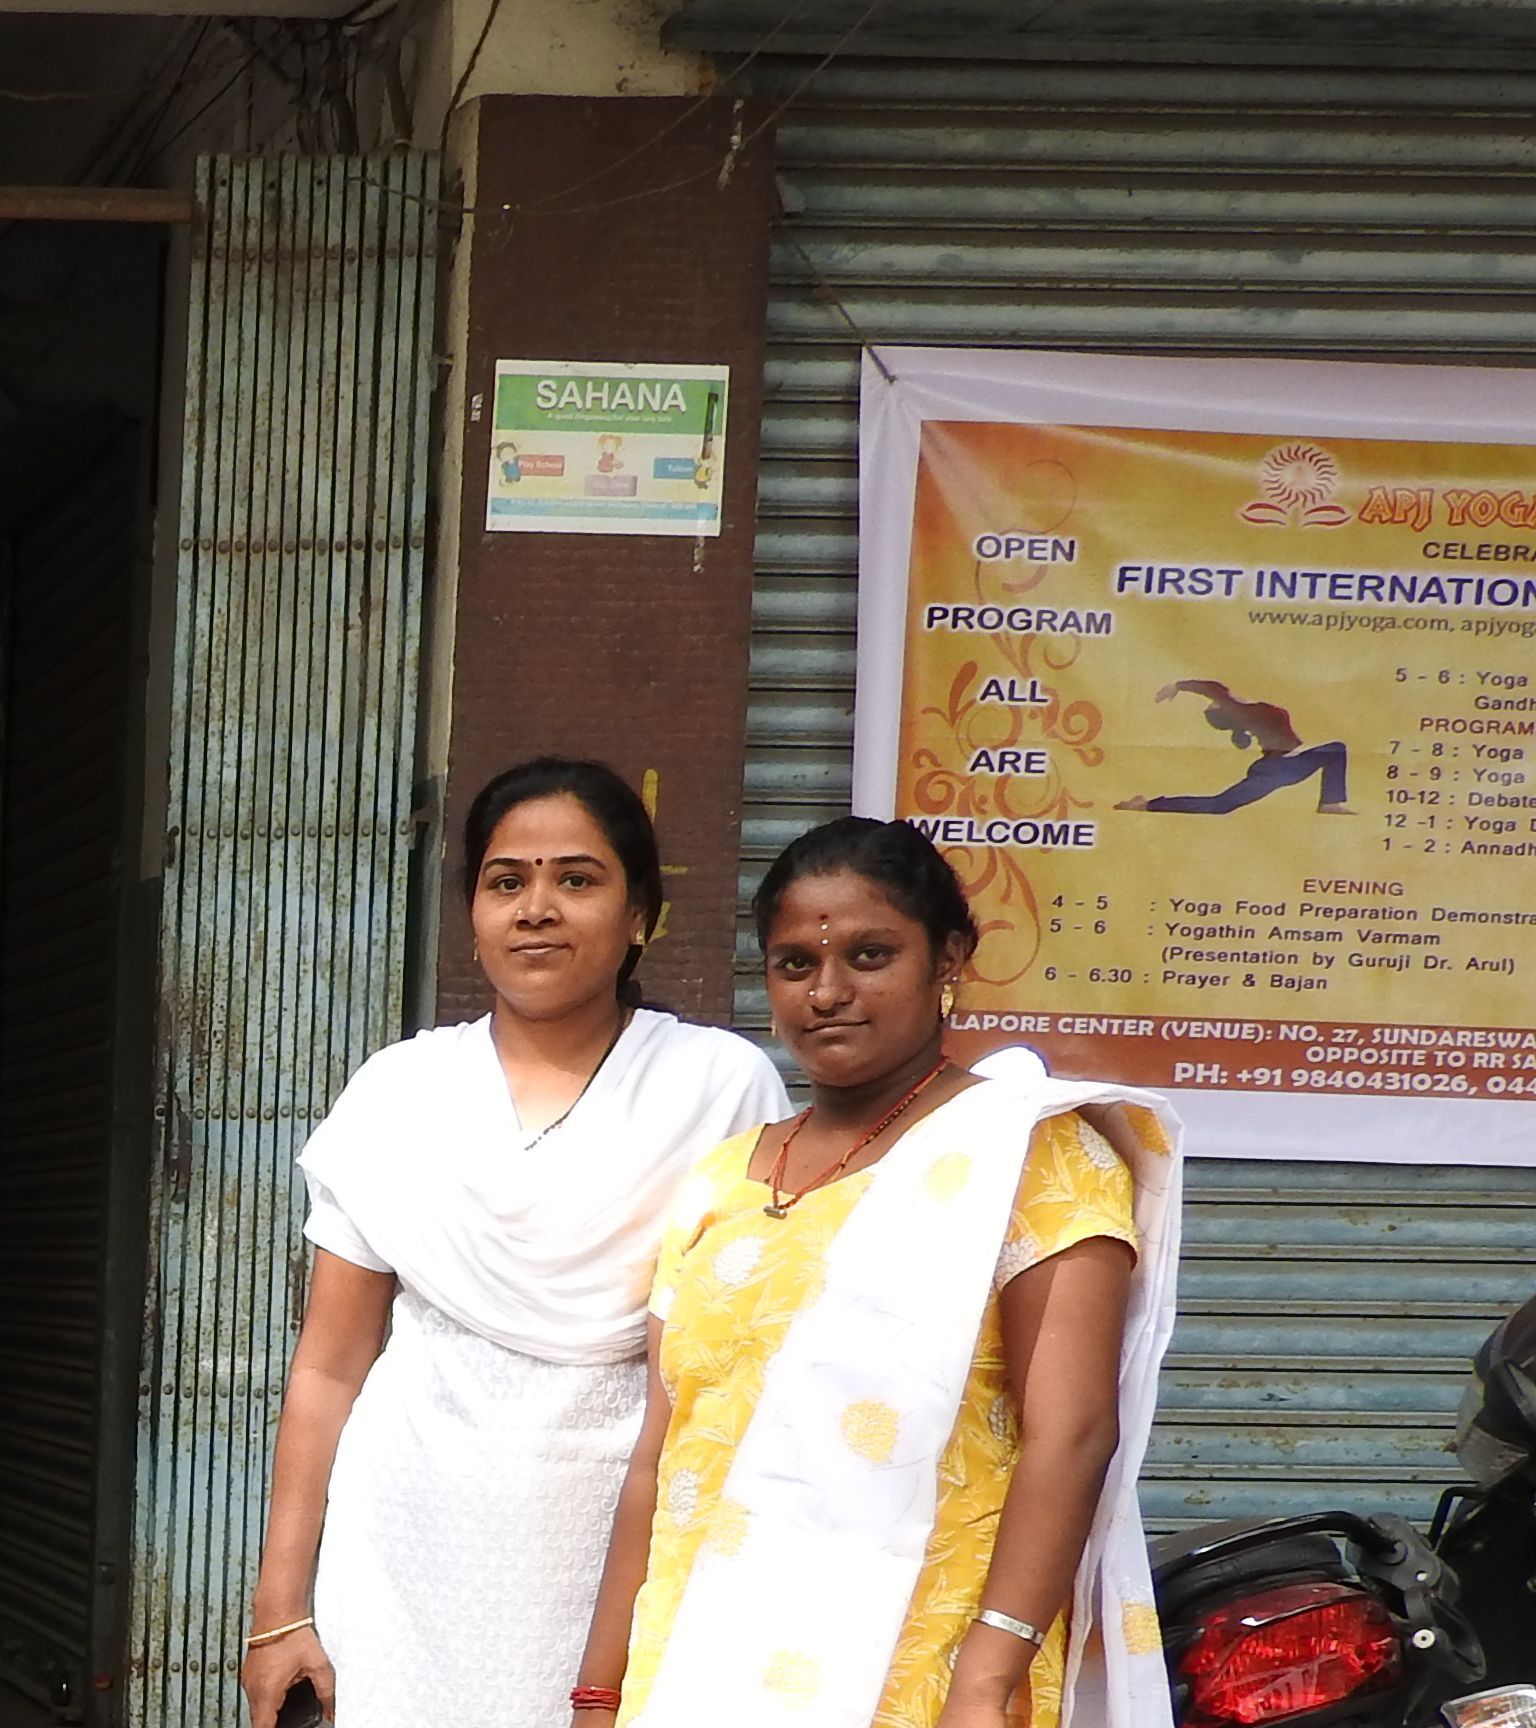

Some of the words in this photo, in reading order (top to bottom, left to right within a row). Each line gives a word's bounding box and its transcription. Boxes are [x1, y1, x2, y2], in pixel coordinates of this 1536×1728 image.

[536, 379, 687, 412] SAHANA
[1358, 486, 1435, 532] APJ
[976, 535, 1076, 562] OPEN
[1117, 565, 1244, 597] FIRST
[927, 606, 1112, 634] PROGRAM
[1248, 611, 1455, 634] www.apjyoga.com,
[979, 679, 1049, 703] ALL
[1395, 668, 1407, 683] 5
[1438, 670, 1450, 684] 6
[1476, 671, 1528, 690] Yoga
[969, 750, 1047, 774] ARE
[1389, 740, 1401, 755] 7
[1431, 742, 1444, 757] 8
[1472, 743, 1524, 763] Yoga
[1386, 765, 1399, 779] 8
[1429, 766, 1442, 781] 9
[1473, 768, 1525, 787] Yoga
[1386, 789, 1440, 805] 10-12
[909, 818, 1095, 847] WELCOME
[1384, 813, 1406, 828] 12
[1464, 816, 1516, 834] Yoga
[1382, 837, 1391, 851] 1
[1424, 839, 1436, 853] 2
[1303, 879, 1404, 896] EVENING
[1052, 895, 1064, 908] 4
[1096, 895, 1108, 911] 5
[1168, 898, 1222, 917] Yoga
[1236, 901, 1287, 917] Food
[1299, 903, 1418, 922] Preparation
[1049, 918, 1061, 933] 5
[1094, 920, 1106, 934] 6
[1164, 922, 1256, 940] Yogathin
[1268, 926, 1344, 942] Amsam
[1357, 929, 1441, 945] Varmam
[1161, 946, 1299, 965] (Presentation
[1312, 952, 1335, 969] by
[1348, 953, 1411, 972] Guruji
[1423, 955, 1452, 970] Dr.
[1465, 957, 1515, 976] Arul)
[1044, 966, 1057, 981] 6
[1089, 967, 1132, 984] 6.30
[1162, 970, 1230, 989] Prayer
[1242, 974, 1256, 988] &
[1270, 974, 1328, 992] Bajan
[1057, 1016, 1153, 1037] CENTER
[1161, 1021, 1272, 1044] (VENUE):
[1279, 1024, 1324, 1042] NO.
[1331, 1028, 1364, 1046] 27,
[1306, 1046, 1427, 1066] OPPOSITE
[1434, 1051, 1466, 1067] TO
[1472, 1052, 1505, 1068] RR
[1174, 1062, 1228, 1085] PH:
[1236, 1067, 1281, 1086] +91
[1291, 1068, 1477, 1096] 9840431026,
